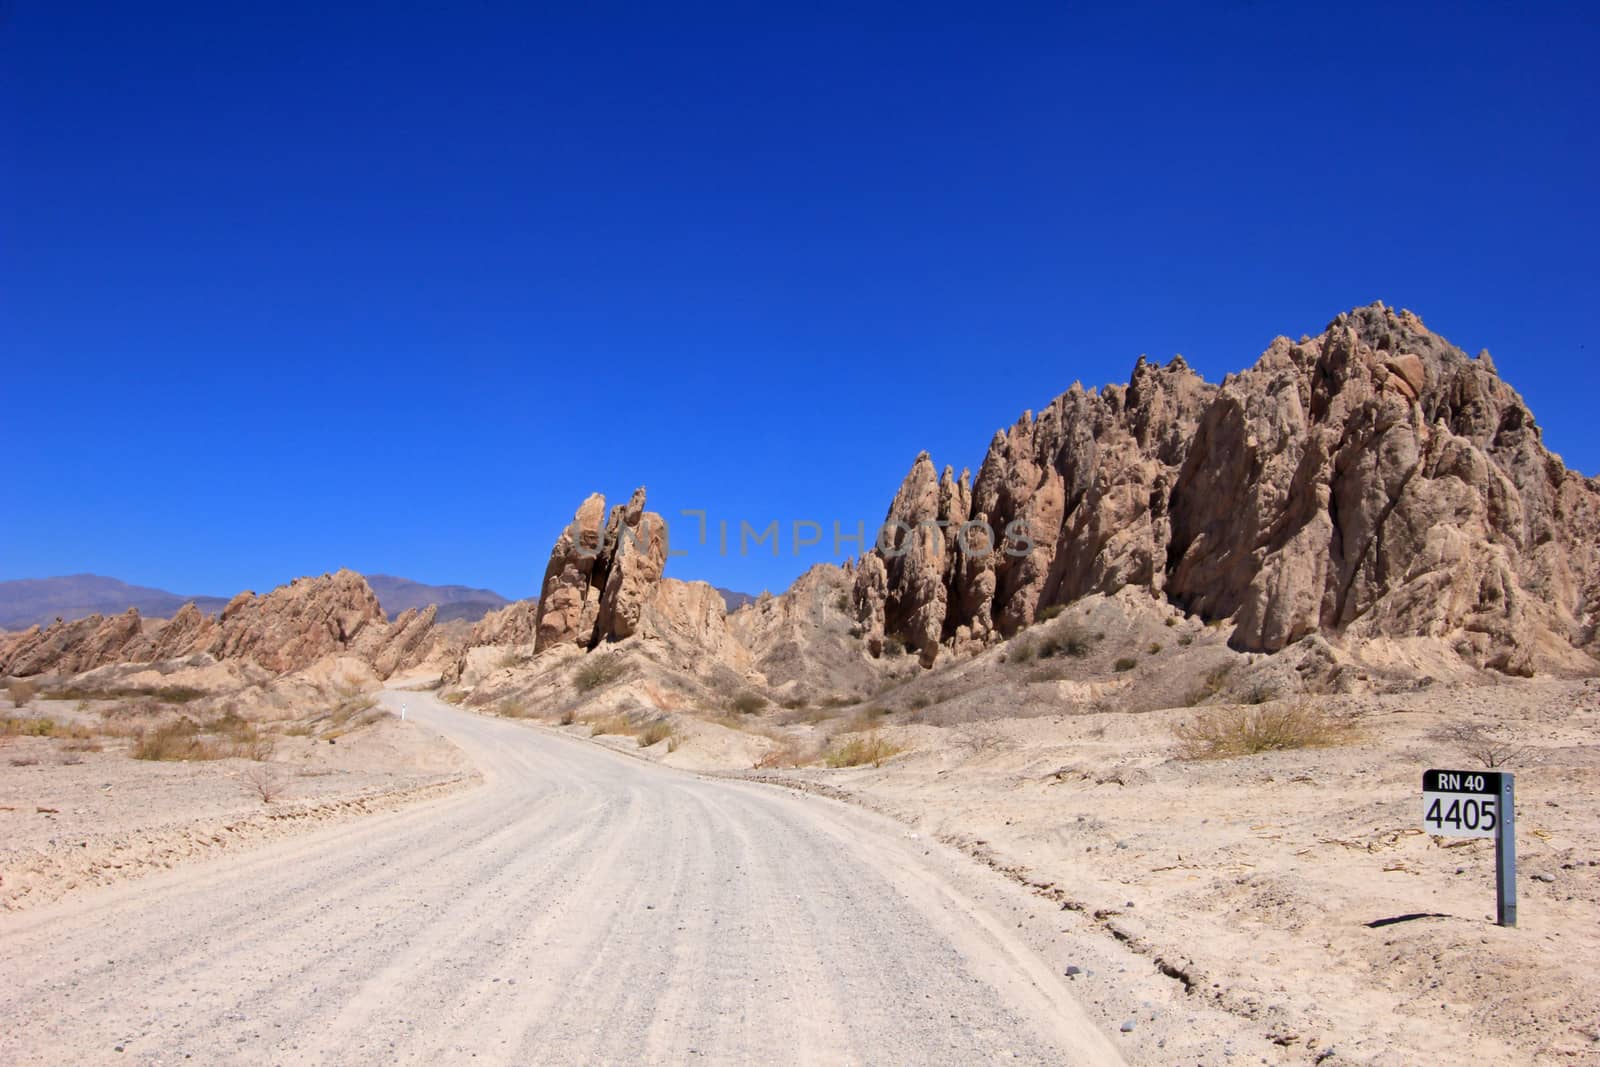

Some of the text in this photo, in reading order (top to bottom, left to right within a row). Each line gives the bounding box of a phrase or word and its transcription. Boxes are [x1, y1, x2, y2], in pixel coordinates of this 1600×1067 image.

[1438, 773, 1485, 791] RN 40
[1425, 798, 1497, 831] 4405
